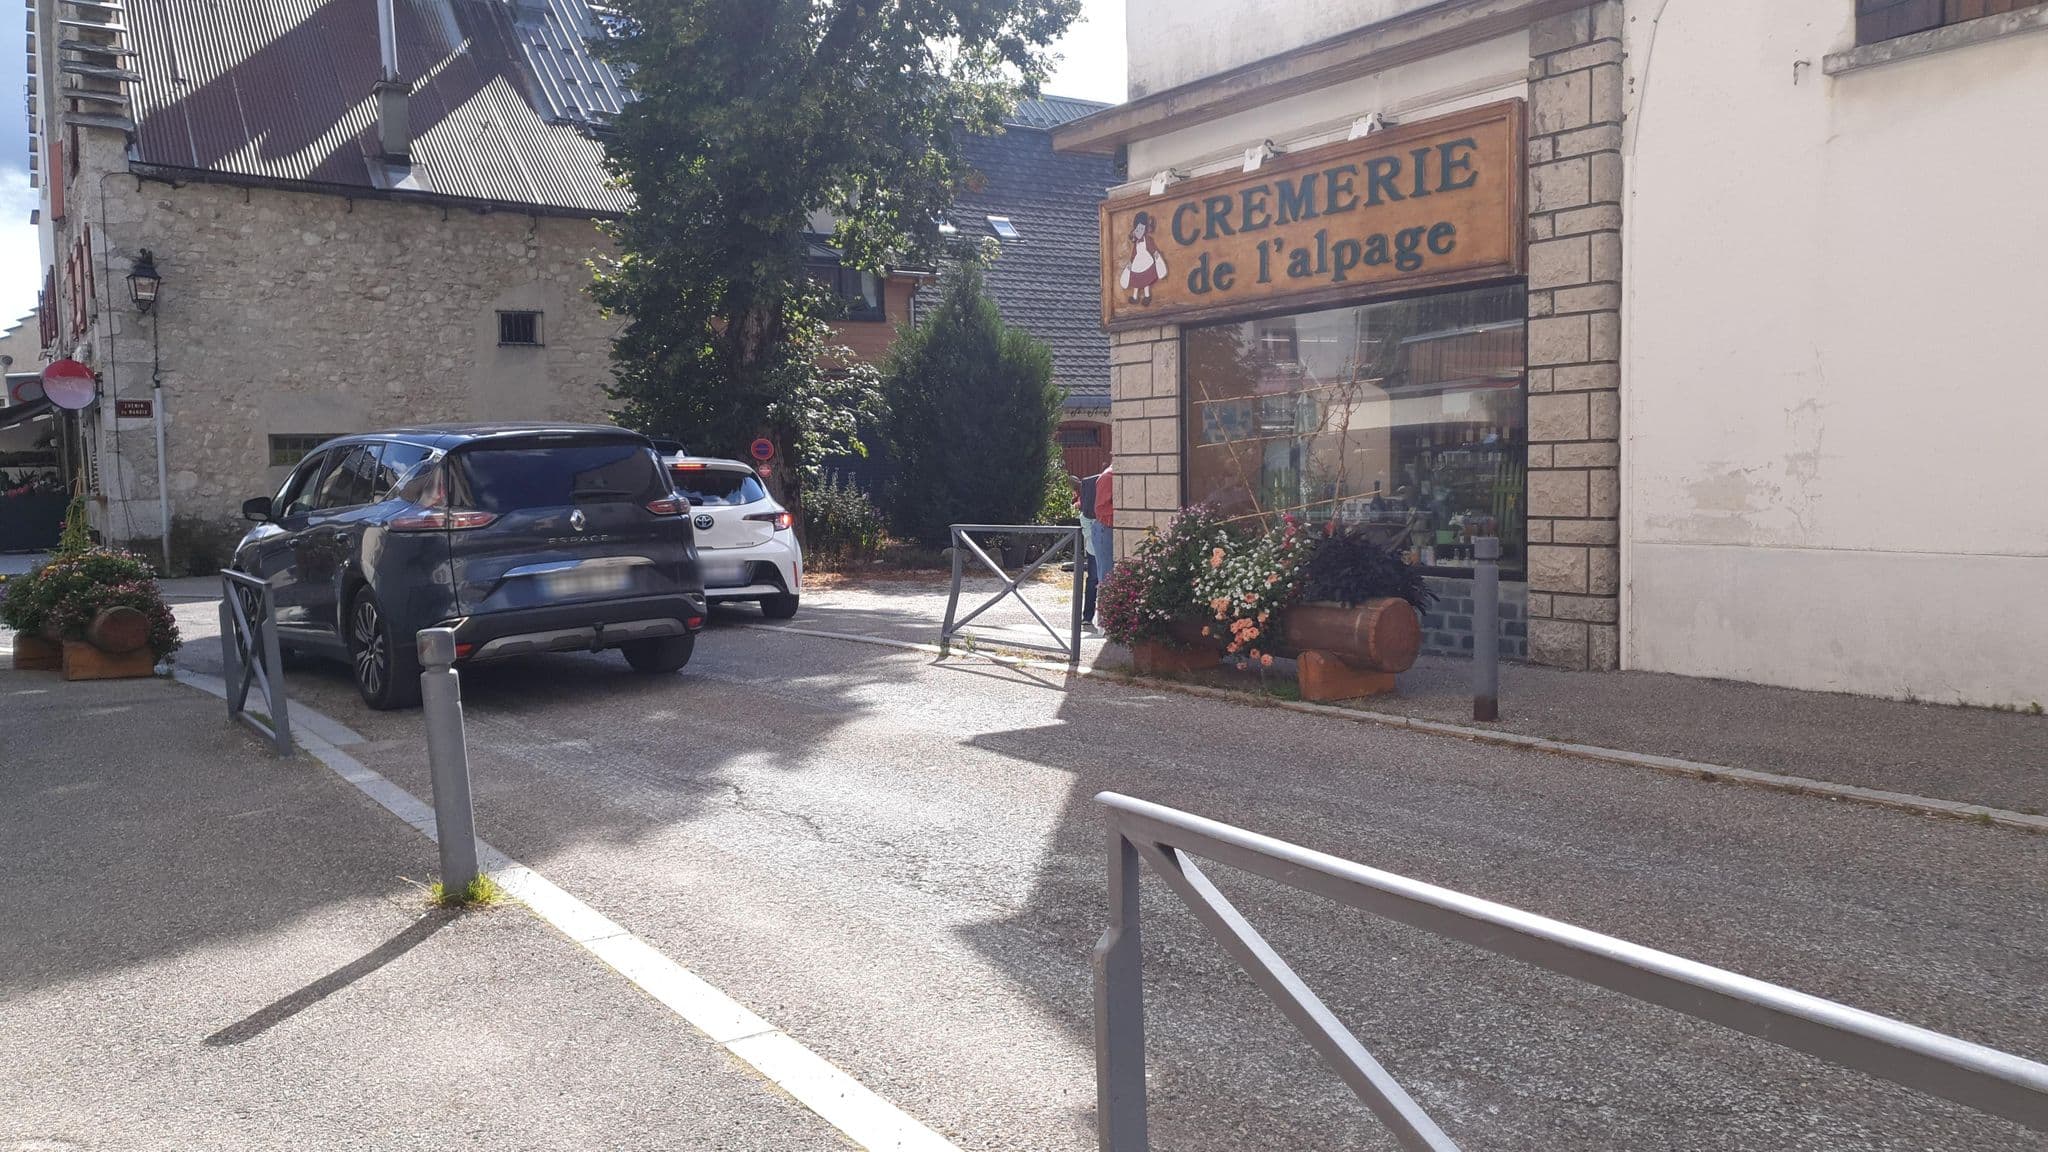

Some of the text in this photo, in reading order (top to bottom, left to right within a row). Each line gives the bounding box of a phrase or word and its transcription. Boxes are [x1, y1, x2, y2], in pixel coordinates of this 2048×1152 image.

[1171, 137, 1479, 247] CREMERIE
[1187, 221, 1458, 295] de l'alpage
[547, 534, 609, 544] ESPACE
